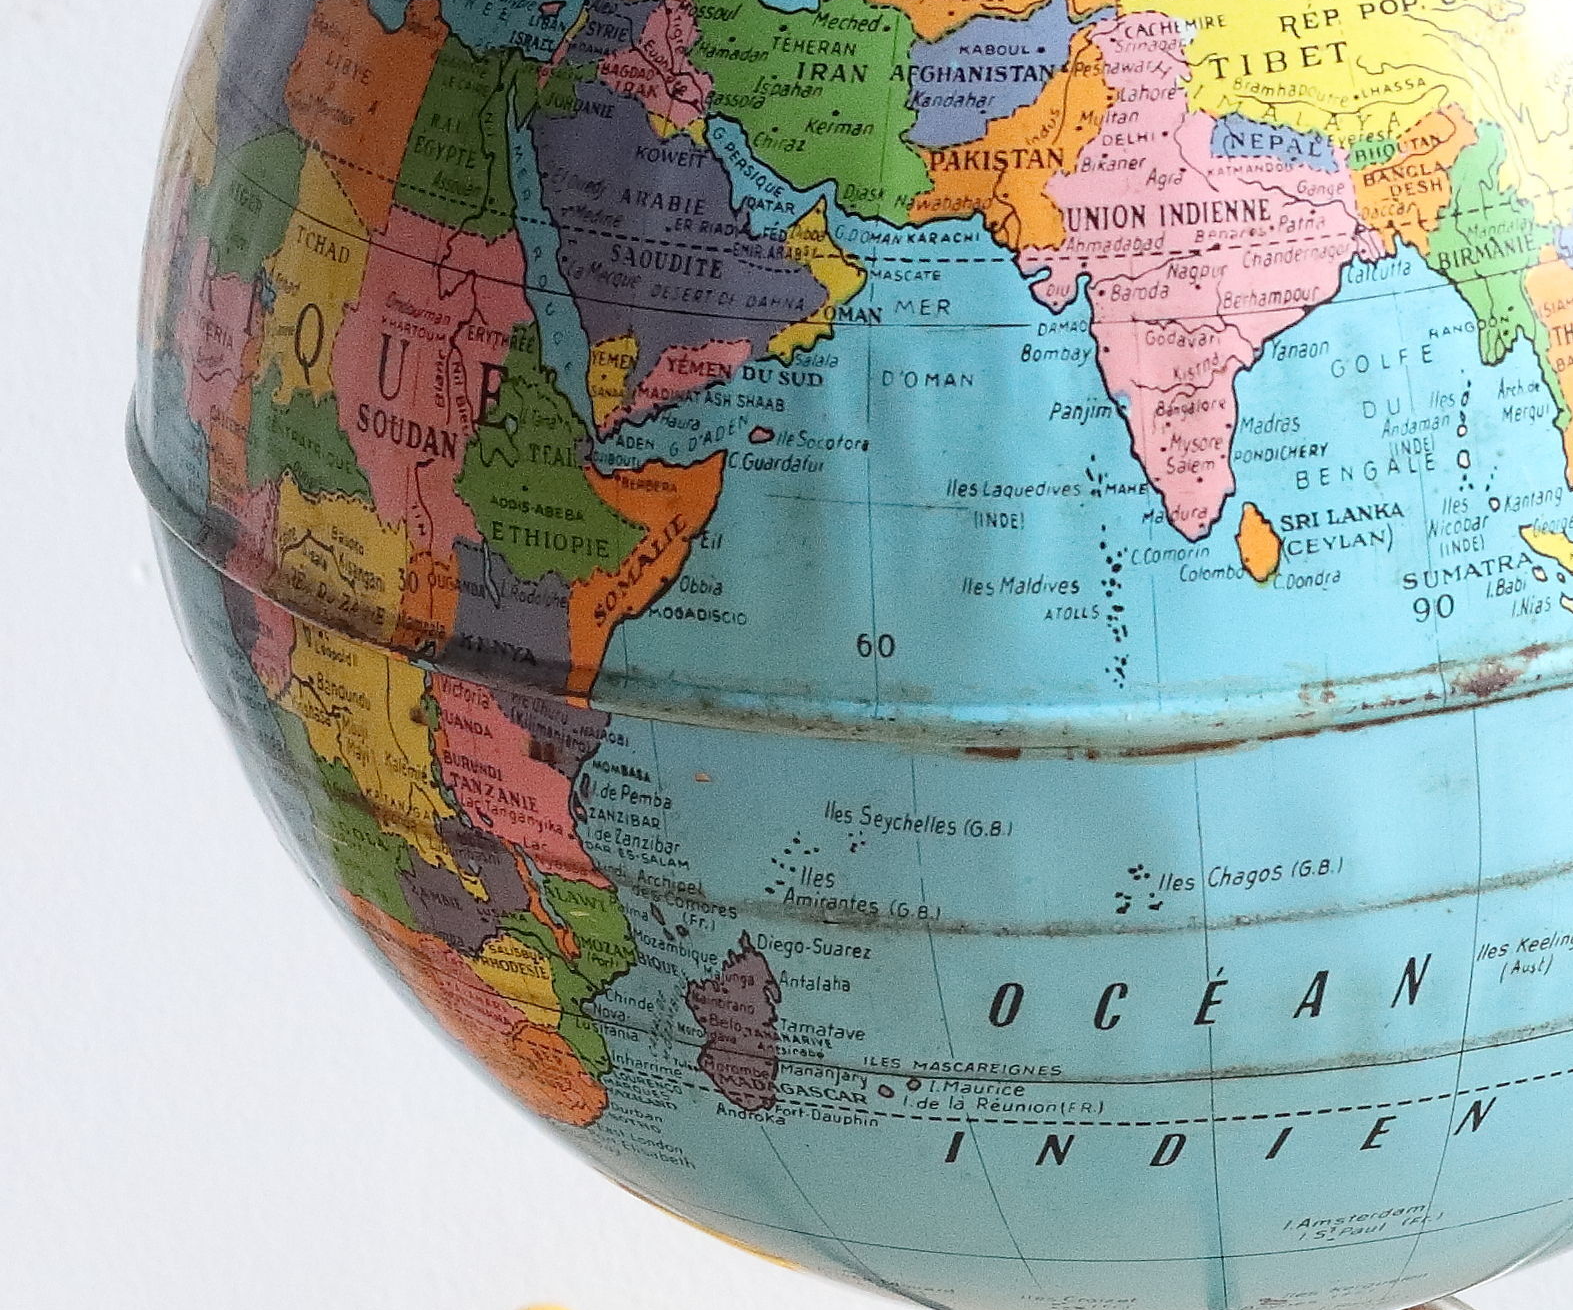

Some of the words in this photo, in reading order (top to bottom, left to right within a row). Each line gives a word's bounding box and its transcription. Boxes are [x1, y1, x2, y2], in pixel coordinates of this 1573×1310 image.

[1123, 14, 1227, 40] CACHEMIRE
[772, 36, 856, 56] TEHERAN
[959, 43, 1029, 56] KABOUL
[796, 63, 867, 82] IRAN
[890, 63, 1055, 83] AFGHANISTAN
[1209, 41, 1348, 80] TIBET
[908, 90, 995, 108] Kandahar
[1101, 132, 1155, 147] DELHI
[1223, 133, 1324, 159] NEPAL
[929, 149, 1064, 171] PAKISTAN
[1364, 162, 1447, 186] BANGLA
[1392, 176, 1444, 198] DESH
[622, 192, 706, 216] ARABIE
[1067, 204, 1147, 230] UNION
[1158, 199, 1271, 225] INDIENNE
[906, 231, 980, 244] KARACHI
[610, 247, 724, 279] SAOUDITE
[1166, 260, 1229, 285] Nagpur
[824, 305, 882, 324] OMAN
[895, 299, 951, 315] MER
[1020, 344, 1092, 365] Bombay
[1331, 344, 1434, 379] GOLFE
[666, 356, 733, 380] YÉMEN
[742, 364, 770, 383] DU
[779, 370, 823, 388] SUD
[1049, 401, 1111, 424] Panjim
[1362, 398, 1400, 418] DU
[356, 404, 459, 460] SOUDAN
[1239, 415, 1300, 435] Madras
[1297, 454, 1437, 489] BENGALE
[983, 480, 1081, 499] Laquedives
[1281, 510, 1320, 531] SRI
[1326, 502, 1405, 525] LANKA
[491, 521, 609, 559] ETHIOPIE
[1282, 524, 1394, 560] (CEYLAN)
[594, 512, 689, 628] SOMALIE
[1402, 553, 1533, 590] SUMATRA
[999, 576, 1080, 595] Maldives
[1045, 605, 1100, 621] ATOLLS
[1412, 594, 1455, 623] 90
[857, 633, 895, 658] 60
[825, 801, 853, 824] Iles
[860, 805, 959, 838] Seychelles
[801, 866, 835, 887] Iles
[1159, 873, 1196, 891] Iles
[1208, 864, 1283, 889] Chagos
[783, 889, 879, 917] Amirantes
[756, 934, 873, 960] Diego-Suarez
[1477, 943, 1509, 962] Iles
[989, 953, 1432, 1031] OCÉAN
[781, 1017, 866, 1042] Tamatave
[864, 1056, 900, 1070] ILES
[913, 1060, 1063, 1077] MASCAREIGNES
[945, 1097, 1497, 1167] INDIEN
